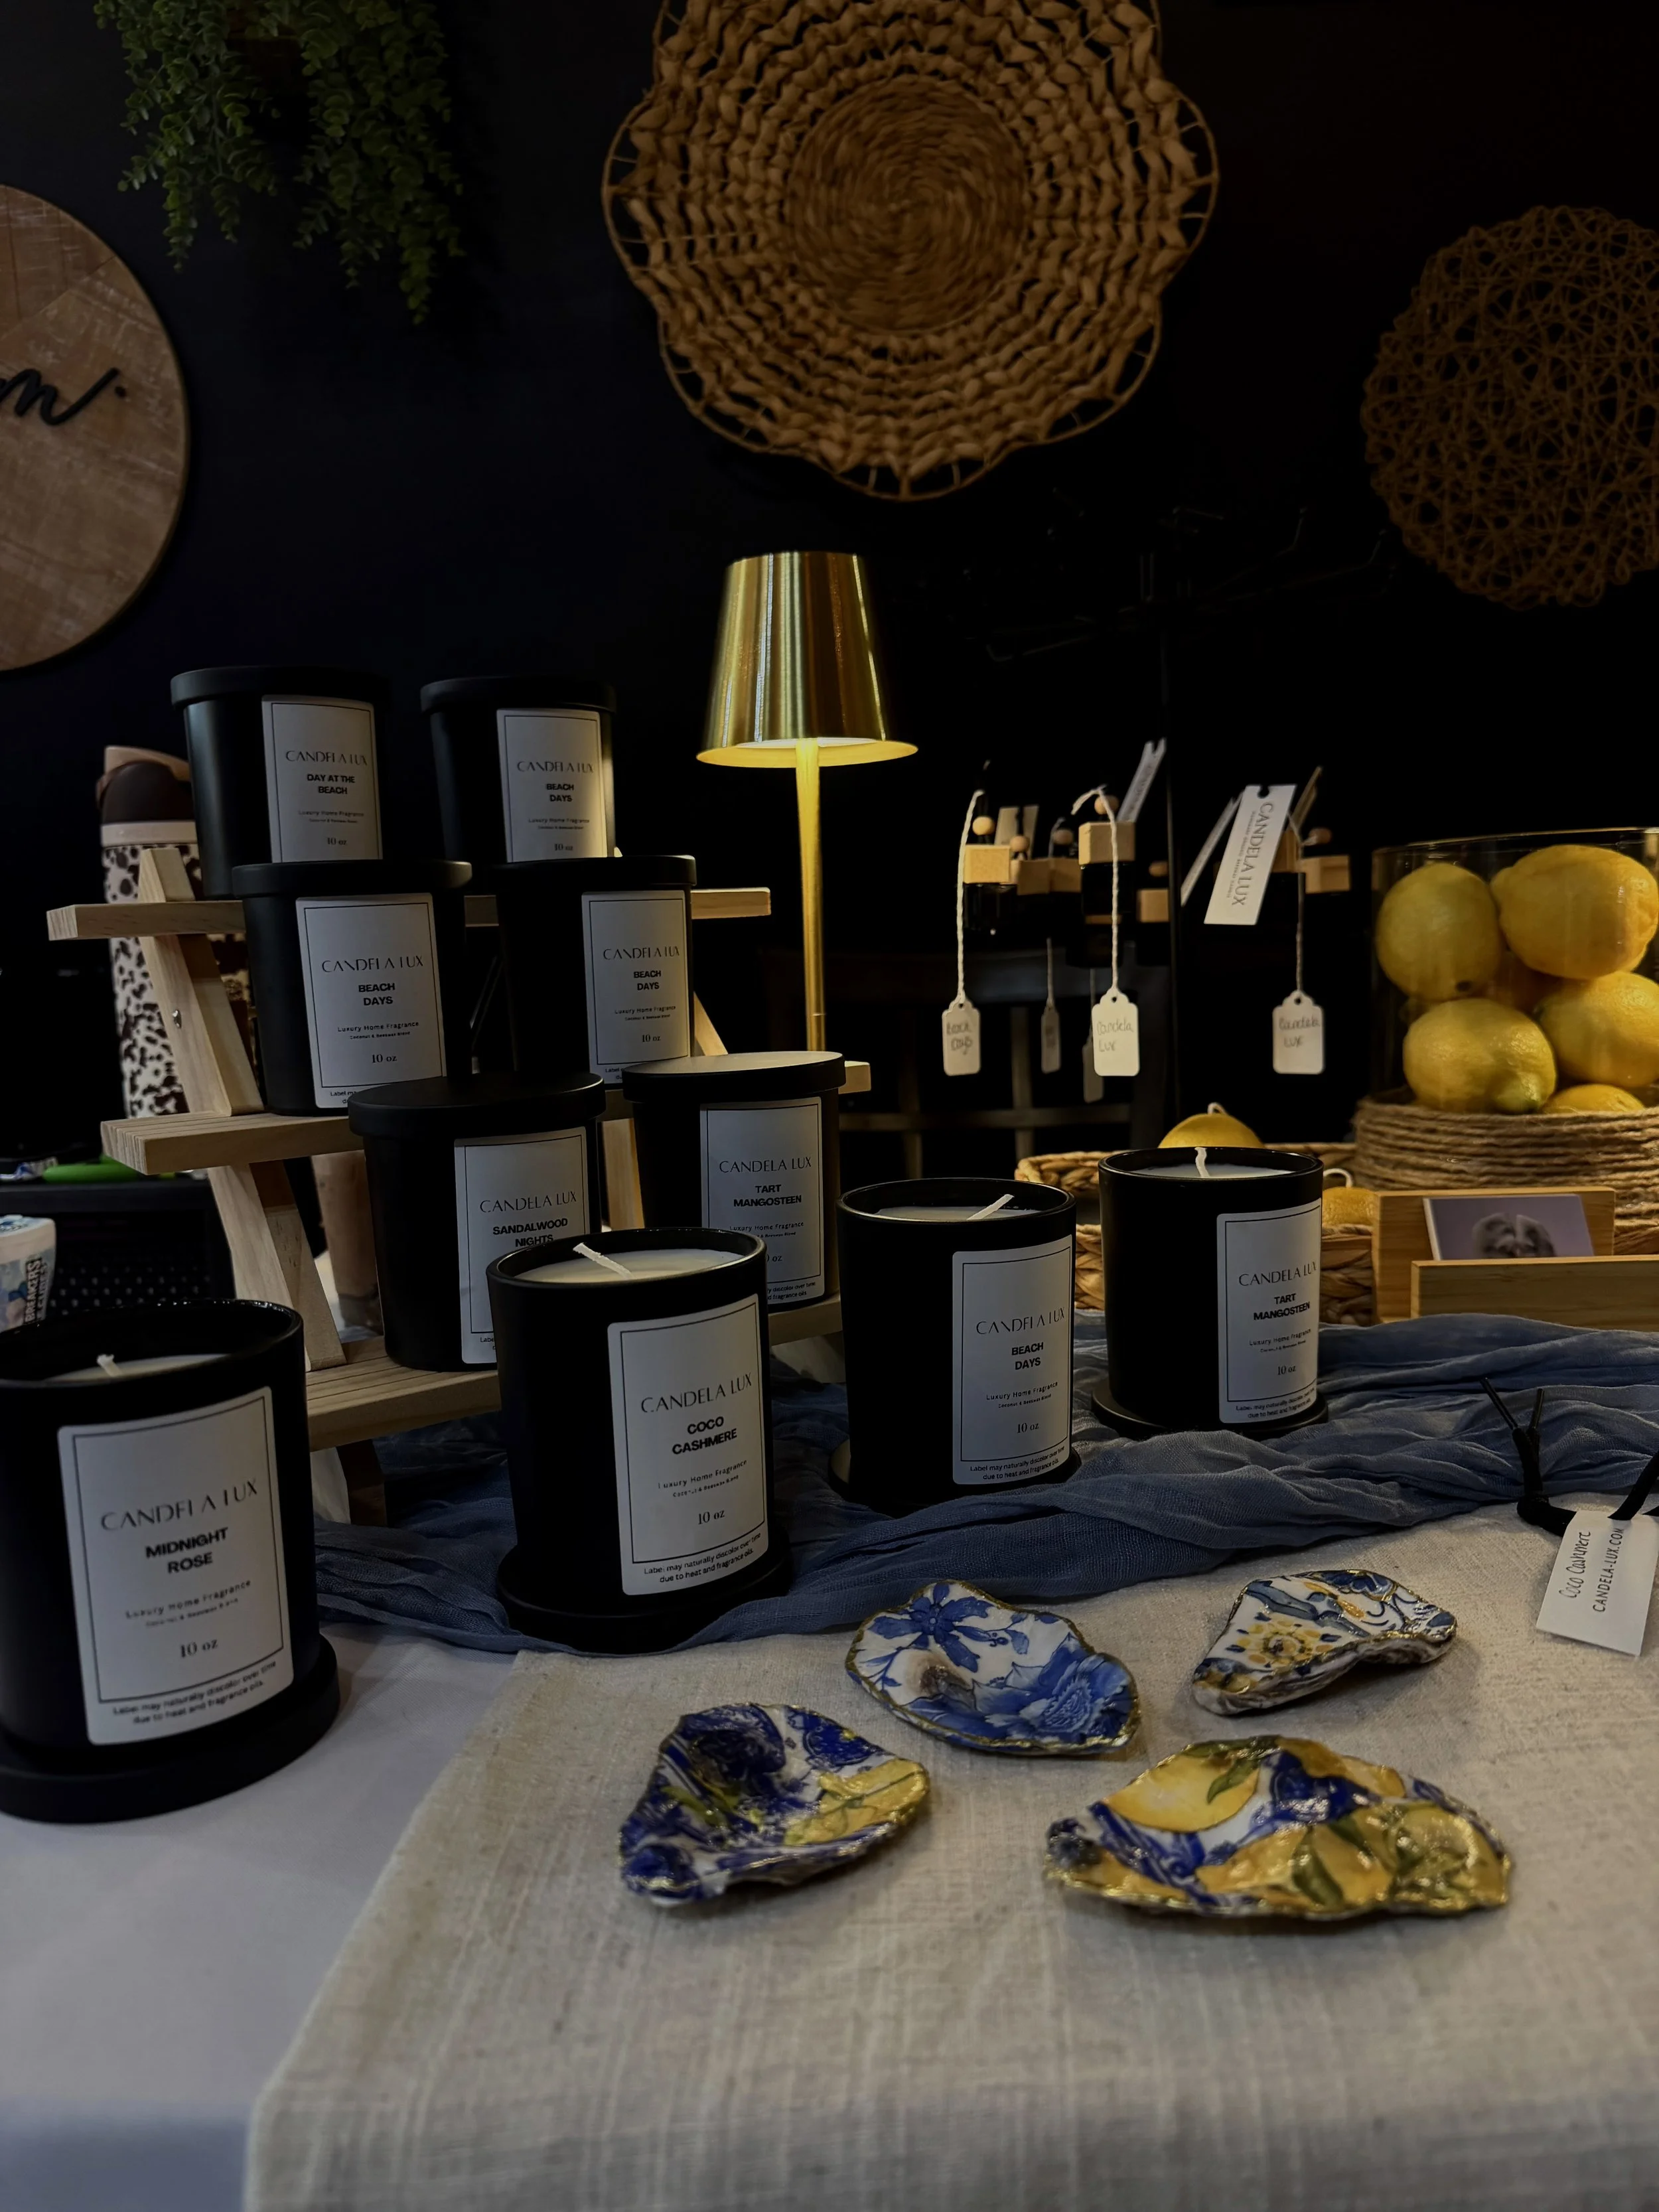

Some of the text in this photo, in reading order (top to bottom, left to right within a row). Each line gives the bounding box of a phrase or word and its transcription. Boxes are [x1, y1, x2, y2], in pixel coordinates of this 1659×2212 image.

[286, 750, 368, 766] CANDELA LUX
[517, 761, 594, 774] CANDELA LUX
[318, 786, 348, 794] BEACH
[1241, 802, 1274, 873] CANDELA
[1232, 876, 1252, 906] LUX
[603, 946, 680, 960] CANDELA LUX
[322, 956, 423, 973] CANDELA LUX
[358, 983, 396, 992] BEACH
[637, 982, 660, 991] DAYS
[363, 996, 393, 1006] DAYS
[386, 1021, 419, 1030] Fragrance
[642, 1034, 651, 1043] 10
[372, 1054, 383, 1063] 10
[719, 1157, 812, 1173] CANDELA LUX
[755, 1184, 782, 1193] TART
[480, 1191, 577, 1213] CANDELA LUX
[734, 1195, 802, 1207] MANGOSTEEN
[493, 1218, 568, 1235] SANDALWOOD
[515, 1234, 553, 1247] NIGHTS
[1239, 1262, 1316, 1286] CANDELA LUX
[1274, 1293, 1296, 1305] TART
[1254, 1301, 1310, 1320] MANGOSTEEN
[976, 1307, 1065, 1334] CANDELA LUX
[1011, 1342, 1044, 1355] BEACH
[1015, 1357, 1041, 1370] DAYS
[1277, 1366, 1287, 1375] 10
[641, 1372, 752, 1413] CANDELA LUX
[1033, 1381, 1058, 1394] Fragrance
[687, 1416, 724, 1434] COCO
[1017, 1423, 1028, 1434] 10
[672, 1428, 737, 1454] CASHMERE
[1003, 1460, 1029, 1470] naturally
[1030, 1455, 1048, 1465] discolor
[1030, 1463, 1052, 1474] fragrance
[658, 1479, 687, 1489] Luxury
[691, 1473, 713, 1483] Home
[715, 1460, 747, 1476] Fragrance
[101, 1478, 257, 1531] CANDELA LUX
[698, 1510, 725, 1524] 10 oz
[145, 1527, 228, 1558] MIDNIGHT
[168, 1552, 213, 1574] ROSE
[644, 1566, 665, 1574] Label
[667, 1562, 682, 1572] may
[684, 1554, 715, 1568] naturally
[716, 1546, 739, 1559] discolor
[740, 1540, 751, 1549] over
[660, 1574, 674, 1583] due
[685, 1569, 701, 1578] heat
[703, 1565, 715, 1574] and
[717, 1554, 744, 1571] fragrance
[1593, 1528, 1624, 1613] CANDELA-LUX.COM
[1559, 1578, 1584, 1598] Coco
[125, 1605, 164, 1619] Luxury
[169, 1597, 200, 1610] Home
[180, 1639, 218, 1658] 10 oz
[141, 1702, 161, 1712] may
[163, 1692, 204, 1709] naturally
[207, 1678, 240, 1696] discolor
[243, 1670, 259, 1684] over
[133, 1714, 151, 1724] due
[166, 1707, 187, 1719] heat
[189, 1702, 206, 1713] and
[208, 1689, 248, 1708] fragrance
